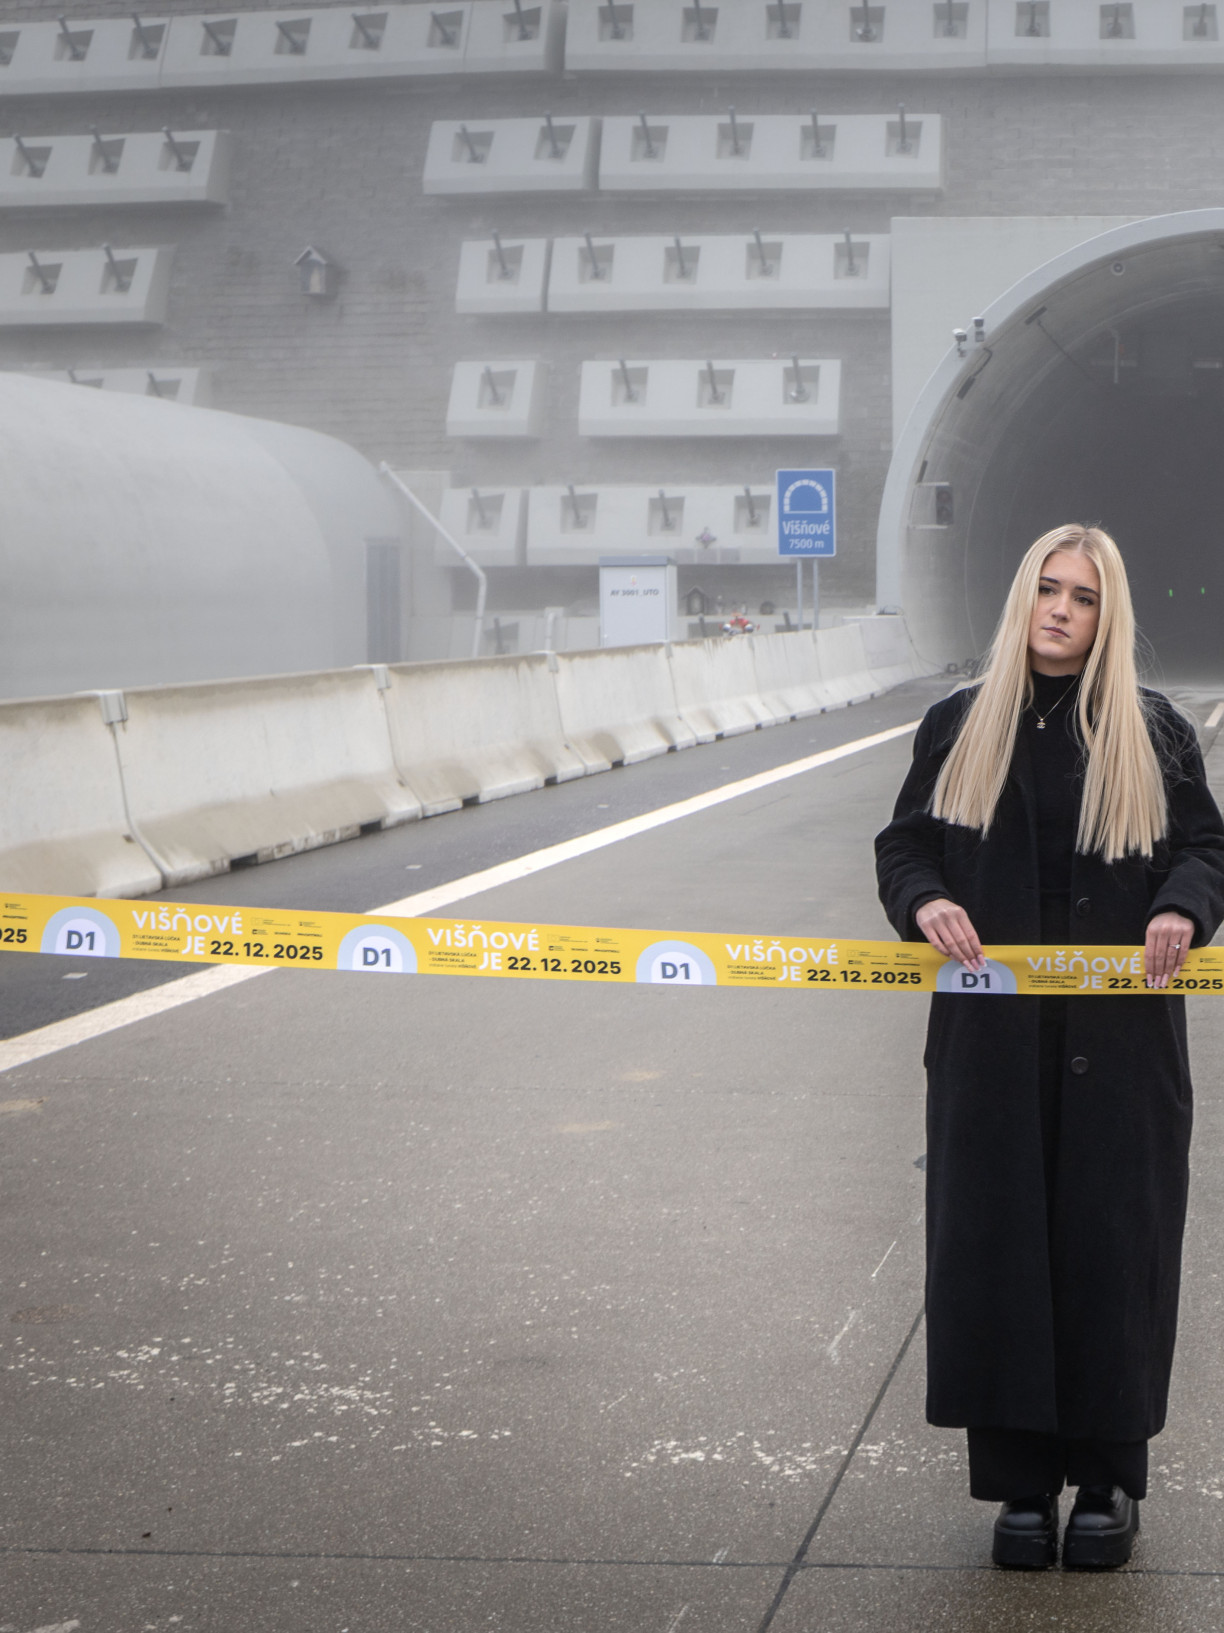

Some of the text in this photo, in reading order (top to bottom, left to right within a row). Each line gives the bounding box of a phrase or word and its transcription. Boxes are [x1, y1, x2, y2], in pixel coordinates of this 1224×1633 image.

[783, 520, 831, 535] Višňové
[789, 539, 825, 549] 7500 m
[132, 907, 243, 935] VIŠŇOVÉ
[67, 930, 95, 950] D1
[180, 935, 205, 955] JE
[427, 924, 540, 952] VIŠŇOVÉ
[363, 947, 391, 967] D1
[478, 951, 502, 971] JE
[725, 939, 839, 965] VIŠŇOVÉ
[662, 962, 690, 979] D1
[1027, 951, 1141, 974] VIŠŇOVÉ
[778, 965, 802, 981] JE
[961, 973, 991, 989] D1
[1079, 975, 1103, 989] JE
